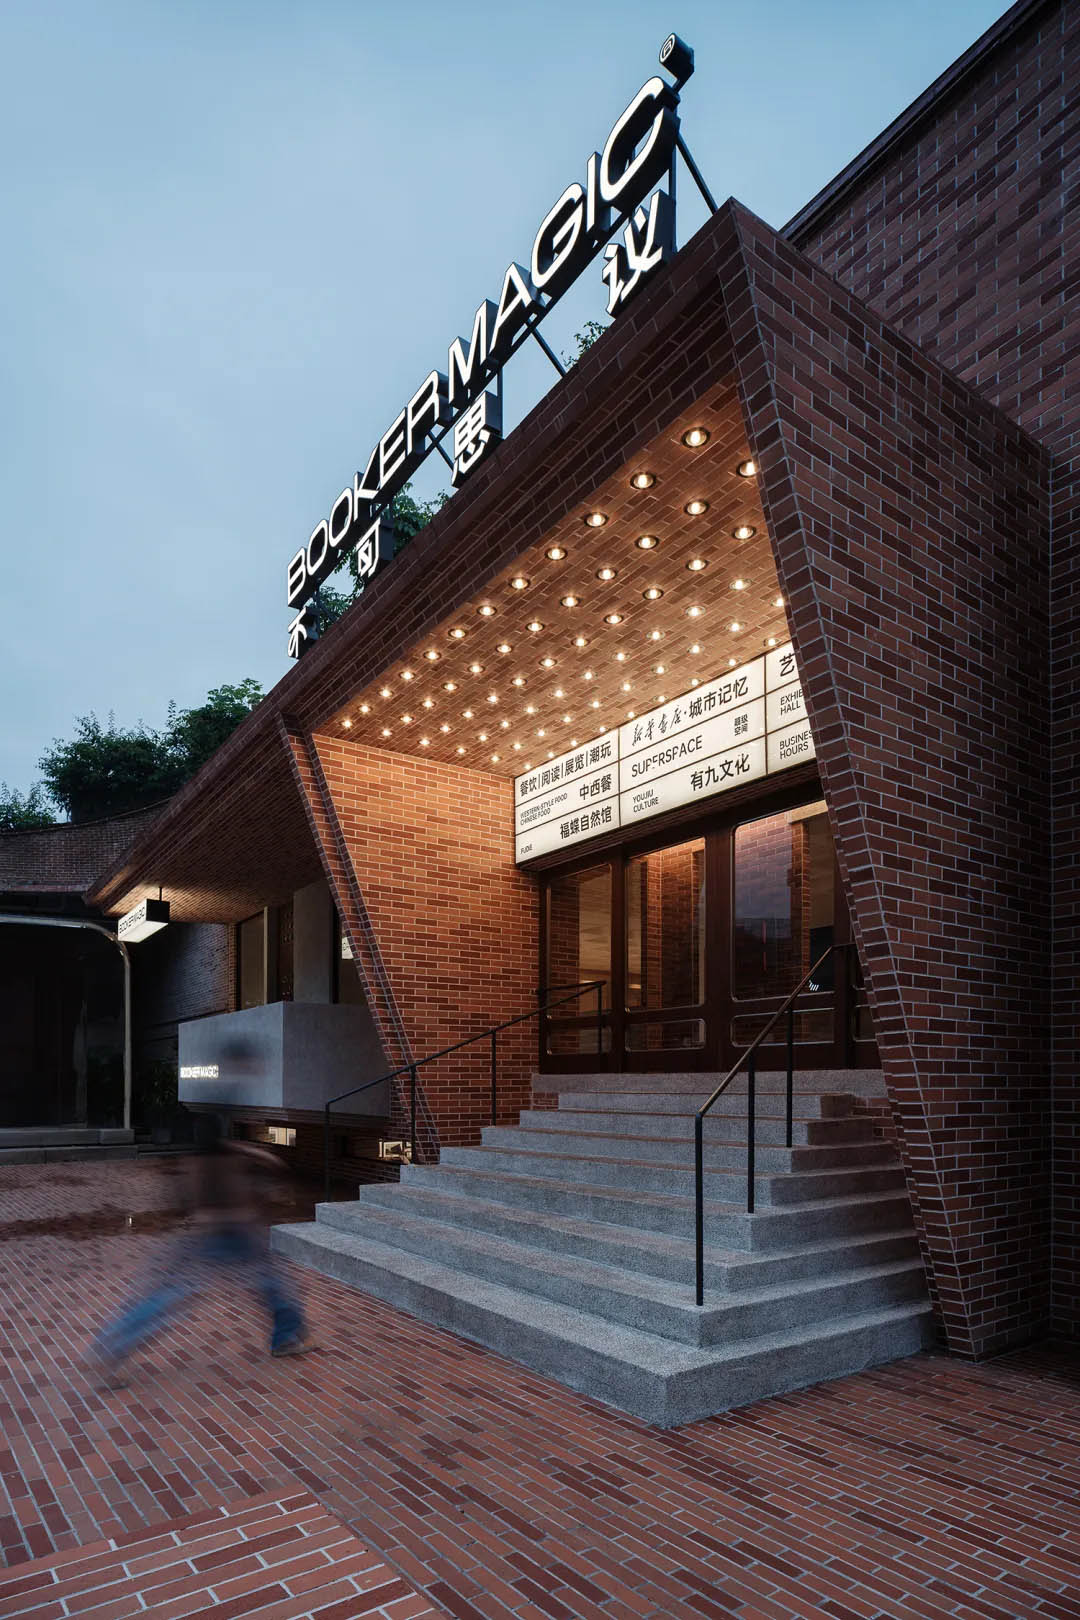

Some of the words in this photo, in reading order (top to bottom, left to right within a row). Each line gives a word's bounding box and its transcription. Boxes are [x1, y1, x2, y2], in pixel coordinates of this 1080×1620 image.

[287, 76, 665, 607] BOOKERMAGIC
[780, 701, 800, 716] HALL
[631, 735, 703, 778] SUPERSPACE
[780, 741, 809, 759] HOURS
[690, 753, 750, 792] 有九文化
[554, 792, 568, 805] FOOD
[579, 774, 612, 801] 中西餐
[633, 796, 659, 813] CULTURE
[520, 813, 539, 826] CHINESE
[538, 807, 551, 819] FOOD
[560, 806, 612, 840] 福蝶自然馆
